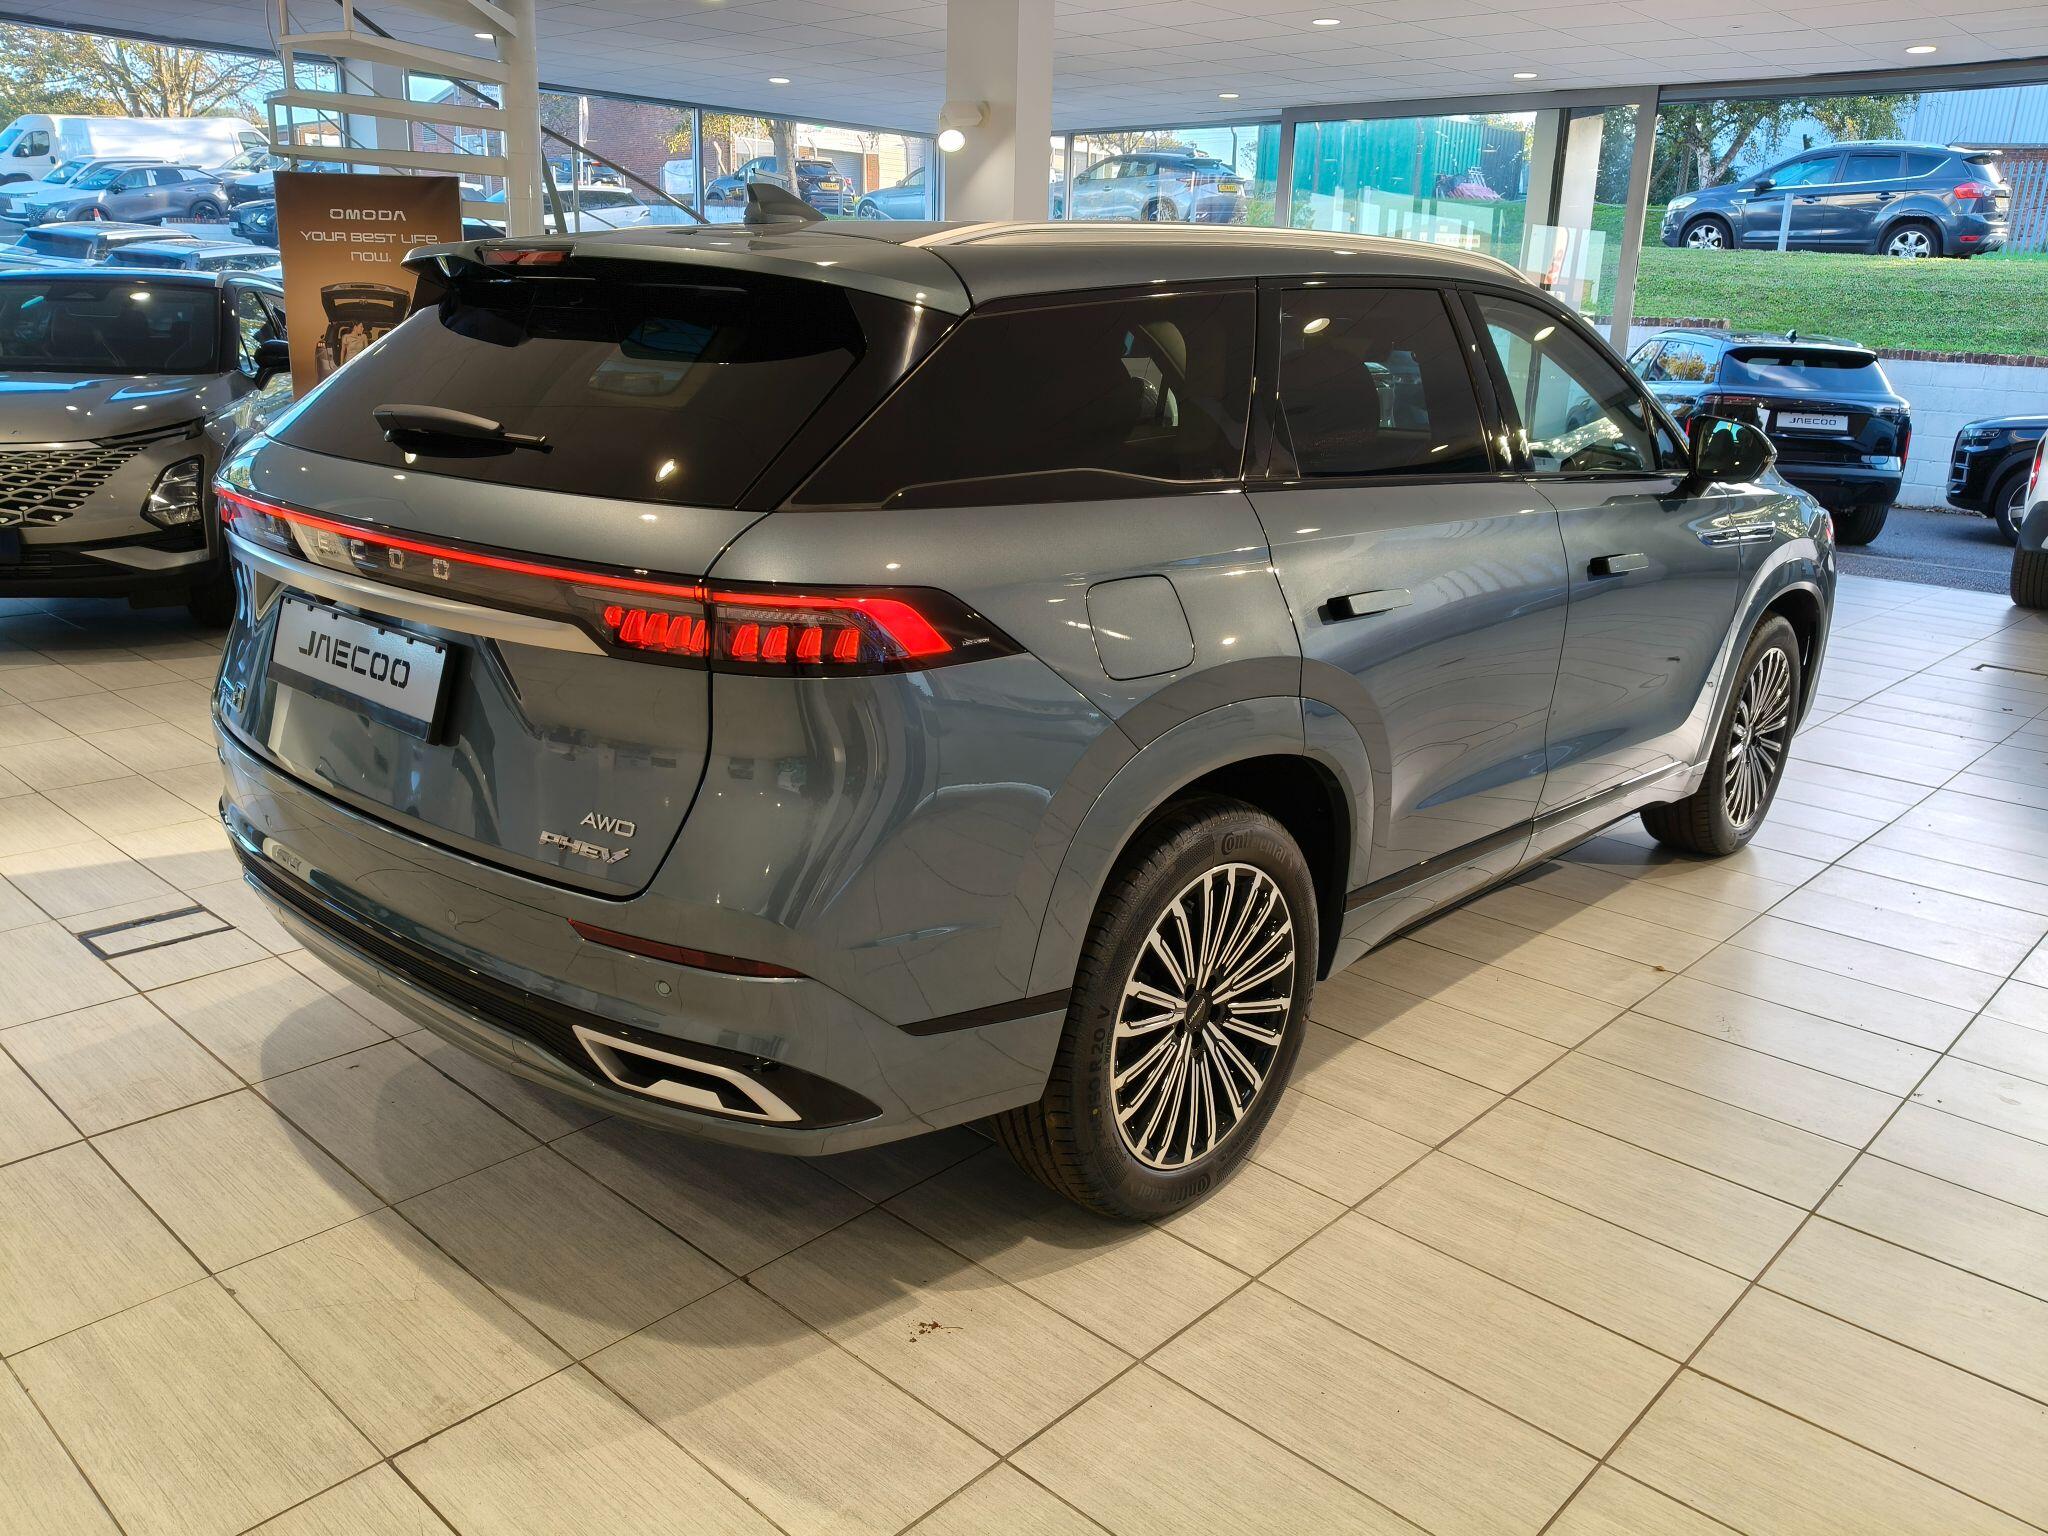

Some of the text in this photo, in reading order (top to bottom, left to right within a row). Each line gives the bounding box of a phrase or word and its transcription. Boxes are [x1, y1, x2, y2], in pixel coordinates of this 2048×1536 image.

[330, 208, 407, 222] OMODA
[300, 231, 347, 242] YOUR
[1789, 416, 1837, 426] JAECOO
[298, 630, 411, 690] JAECOO
[580, 811, 636, 838] AWD
[539, 830, 630, 865] PHEV
